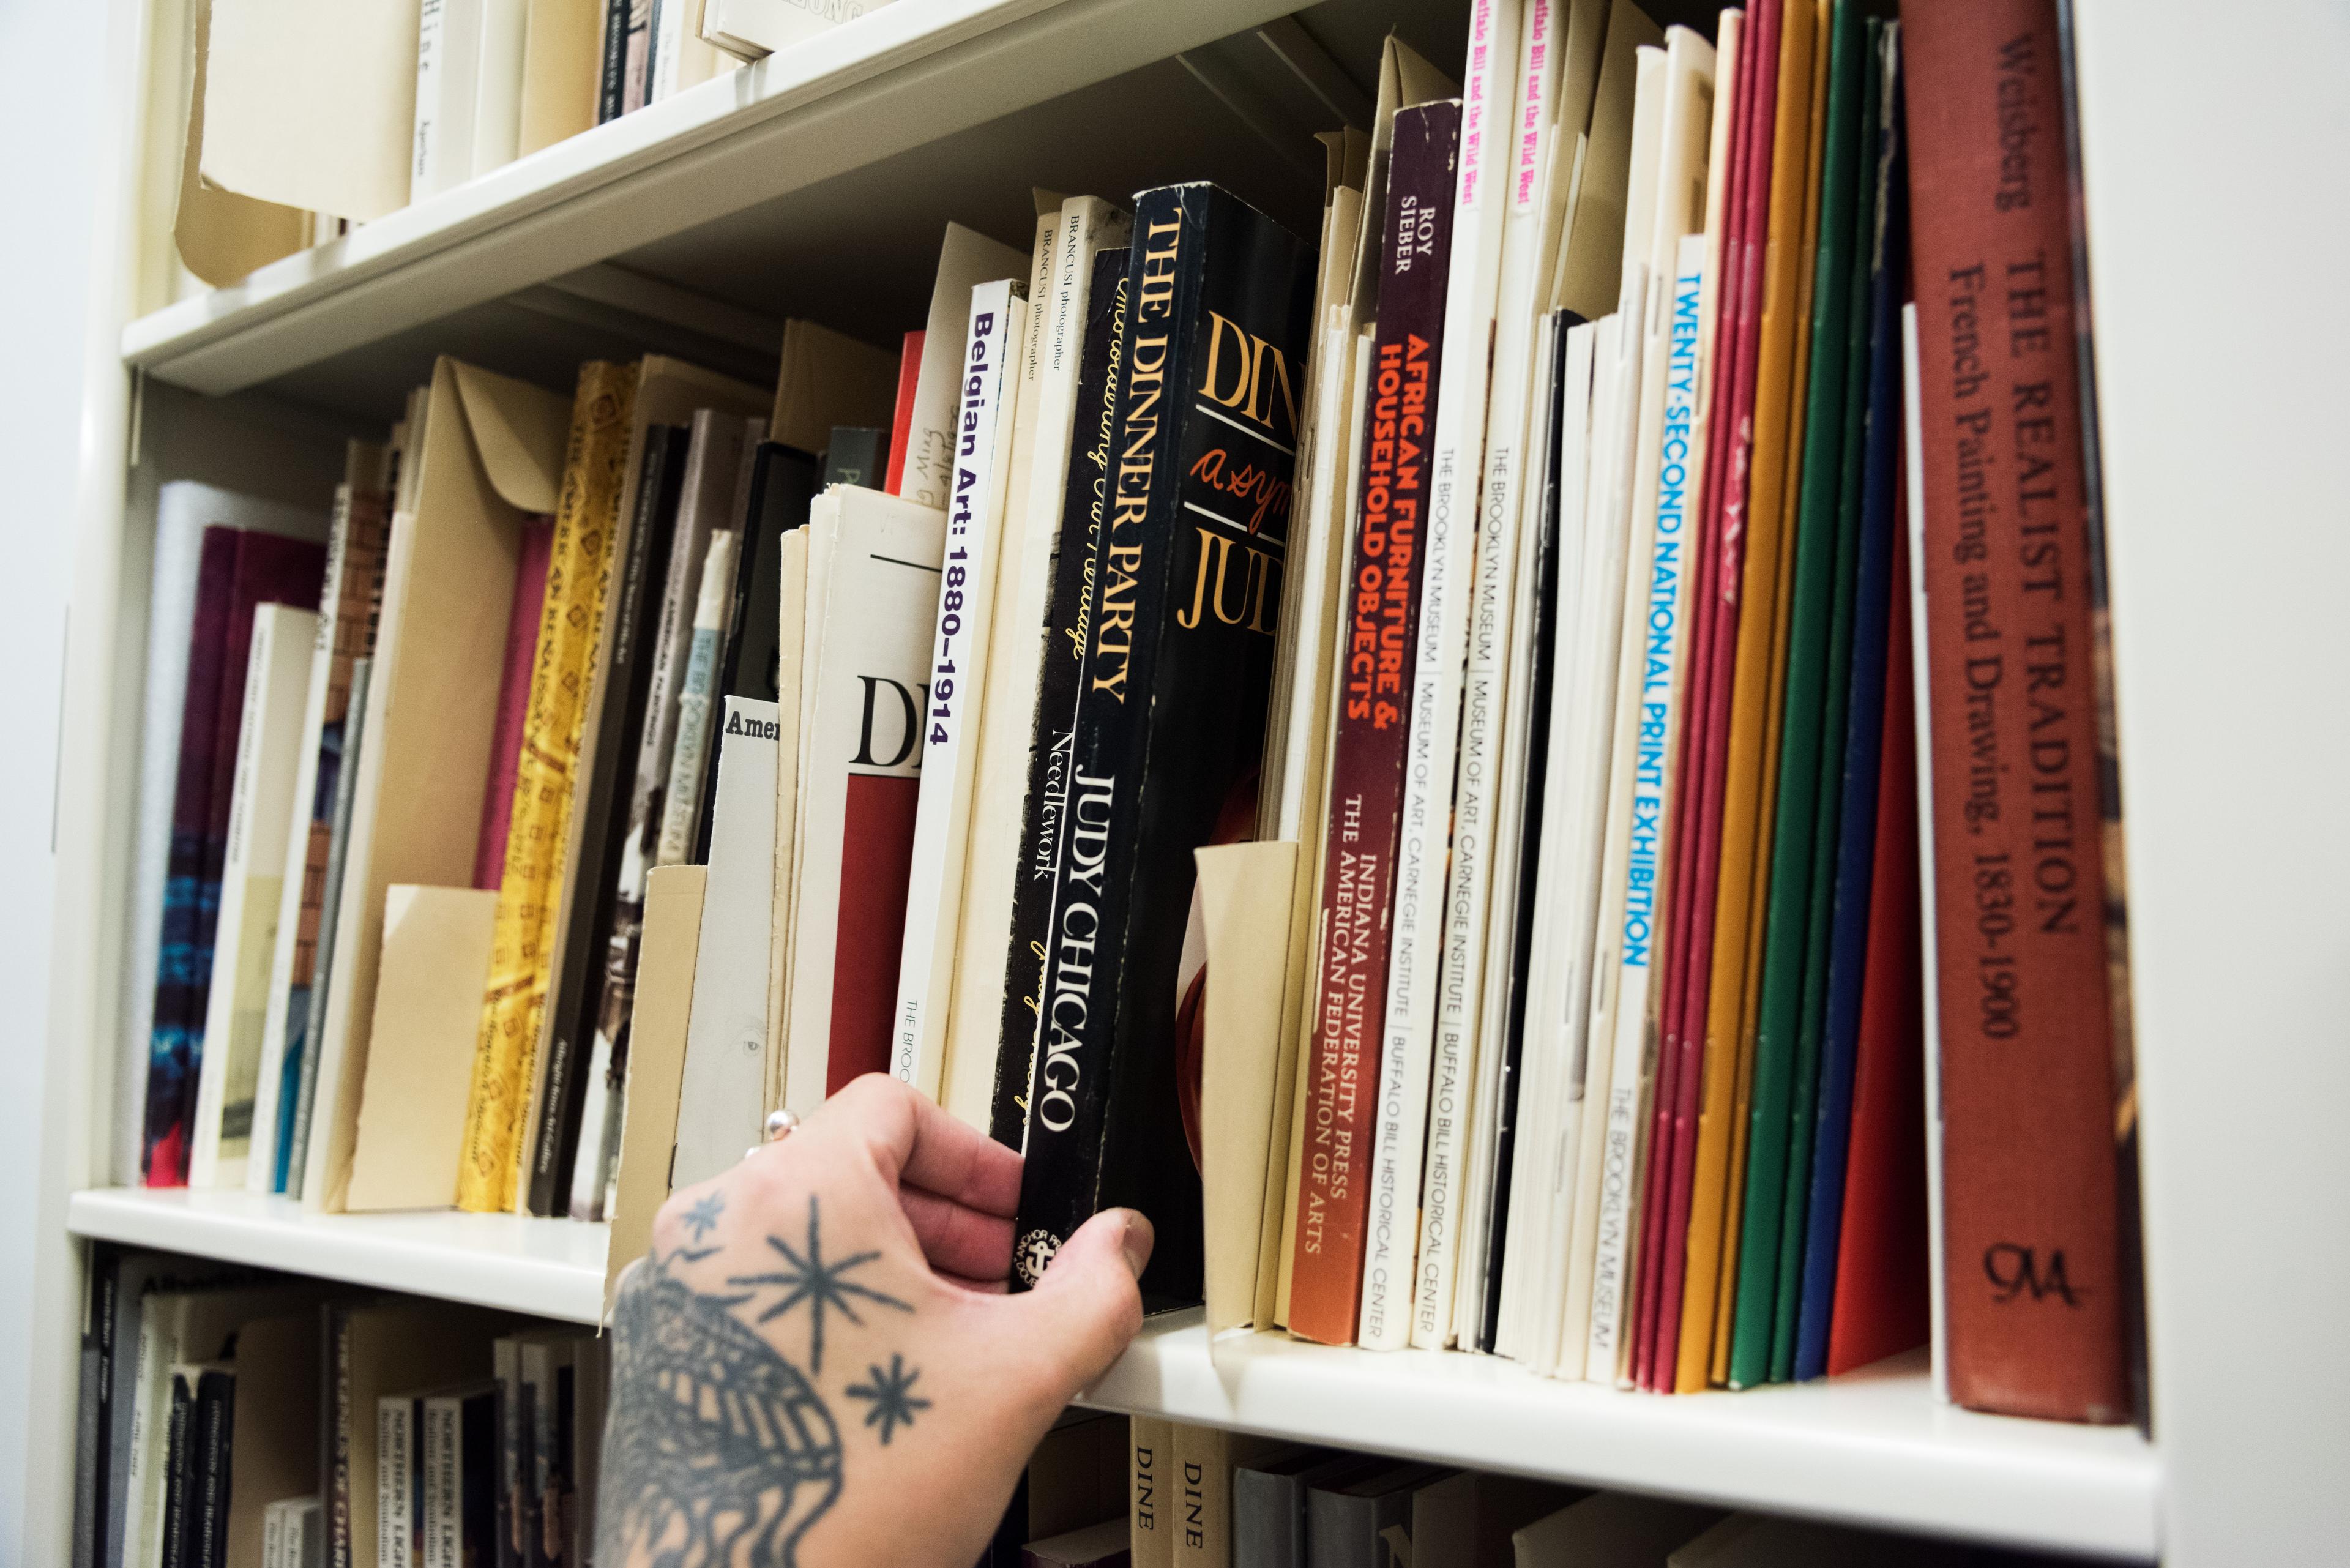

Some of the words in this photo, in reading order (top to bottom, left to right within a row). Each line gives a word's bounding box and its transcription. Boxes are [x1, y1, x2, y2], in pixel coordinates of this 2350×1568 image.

[1471, 75, 1482, 102] and
[1474, 45, 1486, 70] Bill
[1528, 75, 1540, 101] and
[1531, 44, 1545, 70] Bill
[1466, 132, 1479, 166] Wild
[1469, 105, 1480, 129] the
[1521, 132, 1537, 165] Wild
[1524, 105, 1538, 129] the
[1997, 29, 2039, 209] Weisberg
[1463, 170, 1477, 204] West
[1518, 169, 1534, 203] West
[1038, 228, 1054, 300] BRANCUSI
[1064, 215, 1080, 285] BRANCUSI
[1138, 207, 1182, 323] THE
[1396, 196, 1416, 274] SIEBER
[1417, 207, 1435, 255] ROY
[1053, 291, 1070, 371] photographer
[1950, 263, 1989, 399] French
[2008, 248, 2051, 355] THE
[1028, 303, 1043, 382] photographer
[961, 312, 994, 455] Belgian
[1398, 335, 1428, 488] AFRICAN
[1658, 275, 1701, 534] TWENTY-SECOND
[1113, 335, 1168, 530] DINNER
[1190, 449, 1224, 490] a
[1365, 345, 1398, 556] HOUSEHOLD
[1439, 449, 1454, 476] THE
[1493, 448, 1509, 476] THE
[953, 468, 976, 534] Art:
[1954, 408, 1997, 564] Painting
[2014, 381, 2063, 601] REALIST
[1431, 483, 1451, 581] BROOKLYN
[1484, 482, 1505, 579] BROOKLYN
[1092, 545, 1142, 703] PARTY
[1378, 500, 1415, 692] FURNITURE
[1425, 586, 1442, 662] MUSEUM
[1477, 584, 1496, 660] MUSEUM
[1645, 542, 1679, 692] NATIONAL
[1963, 573, 2002, 642] and
[1349, 566, 1379, 719] OBJECTS
[1374, 701, 1397, 728] &
[1417, 682, 1434, 759] MUSEUM
[1469, 681, 1488, 756] MUSEUM
[1638, 703, 1666, 787] PRINT
[1965, 654, 2009, 835] Drawing,
[1035, 730, 1072, 880] Needlework
[1414, 763, 1428, 788] OF
[1466, 761, 1481, 786] OF
[2027, 624, 2078, 933] TRADITION
[1070, 764, 1114, 896] JUDY
[1343, 794, 1361, 842] THE
[1330, 851, 1356, 983] AMERICAN
[1351, 855, 1376, 964] INDIANA
[1401, 838, 1422, 931] CARNEGIE
[1453, 835, 1475, 928] CARNEGIE
[1624, 796, 1660, 966] EXHIBITION
[1395, 938, 1412, 1015] INSTITUTE
[1447, 935, 1466, 1012] INSTITUTE
[1975, 854, 2020, 1039] 1830-1900
[906, 1001, 917, 1025] THE
[1041, 903, 1098, 1131] CHICAGO
[1338, 974, 1365, 1122] UNIVERSITY
[1317, 992, 1343, 1144] FEDERATION
[1387, 1036, 1406, 1117] BUFFALO
[1439, 1032, 1459, 1113] BUFFALO
[1612, 1089, 1632, 1121] THE
[1313, 1153, 1328, 1185] OF
[1331, 1130, 1352, 1198] PRESS
[1383, 1122, 1398, 1152] BILL
[1435, 1118, 1452, 1149] BILL
[1305, 1193, 1324, 1253] ARTS
[1375, 1159, 1395, 1260] HISTORICAL
[1427, 1154, 1447, 1256] HISTORICAL
[1602, 1131, 1627, 1246] BROOKLYN
[1370, 1268, 1387, 1337] CENTER
[1421, 1263, 1439, 1332] CENTER
[1594, 1255, 1617, 1348] MUSEUM
[1138, 1446, 1154, 1530] DINE
[1185, 1461, 1203, 1548] DINE
